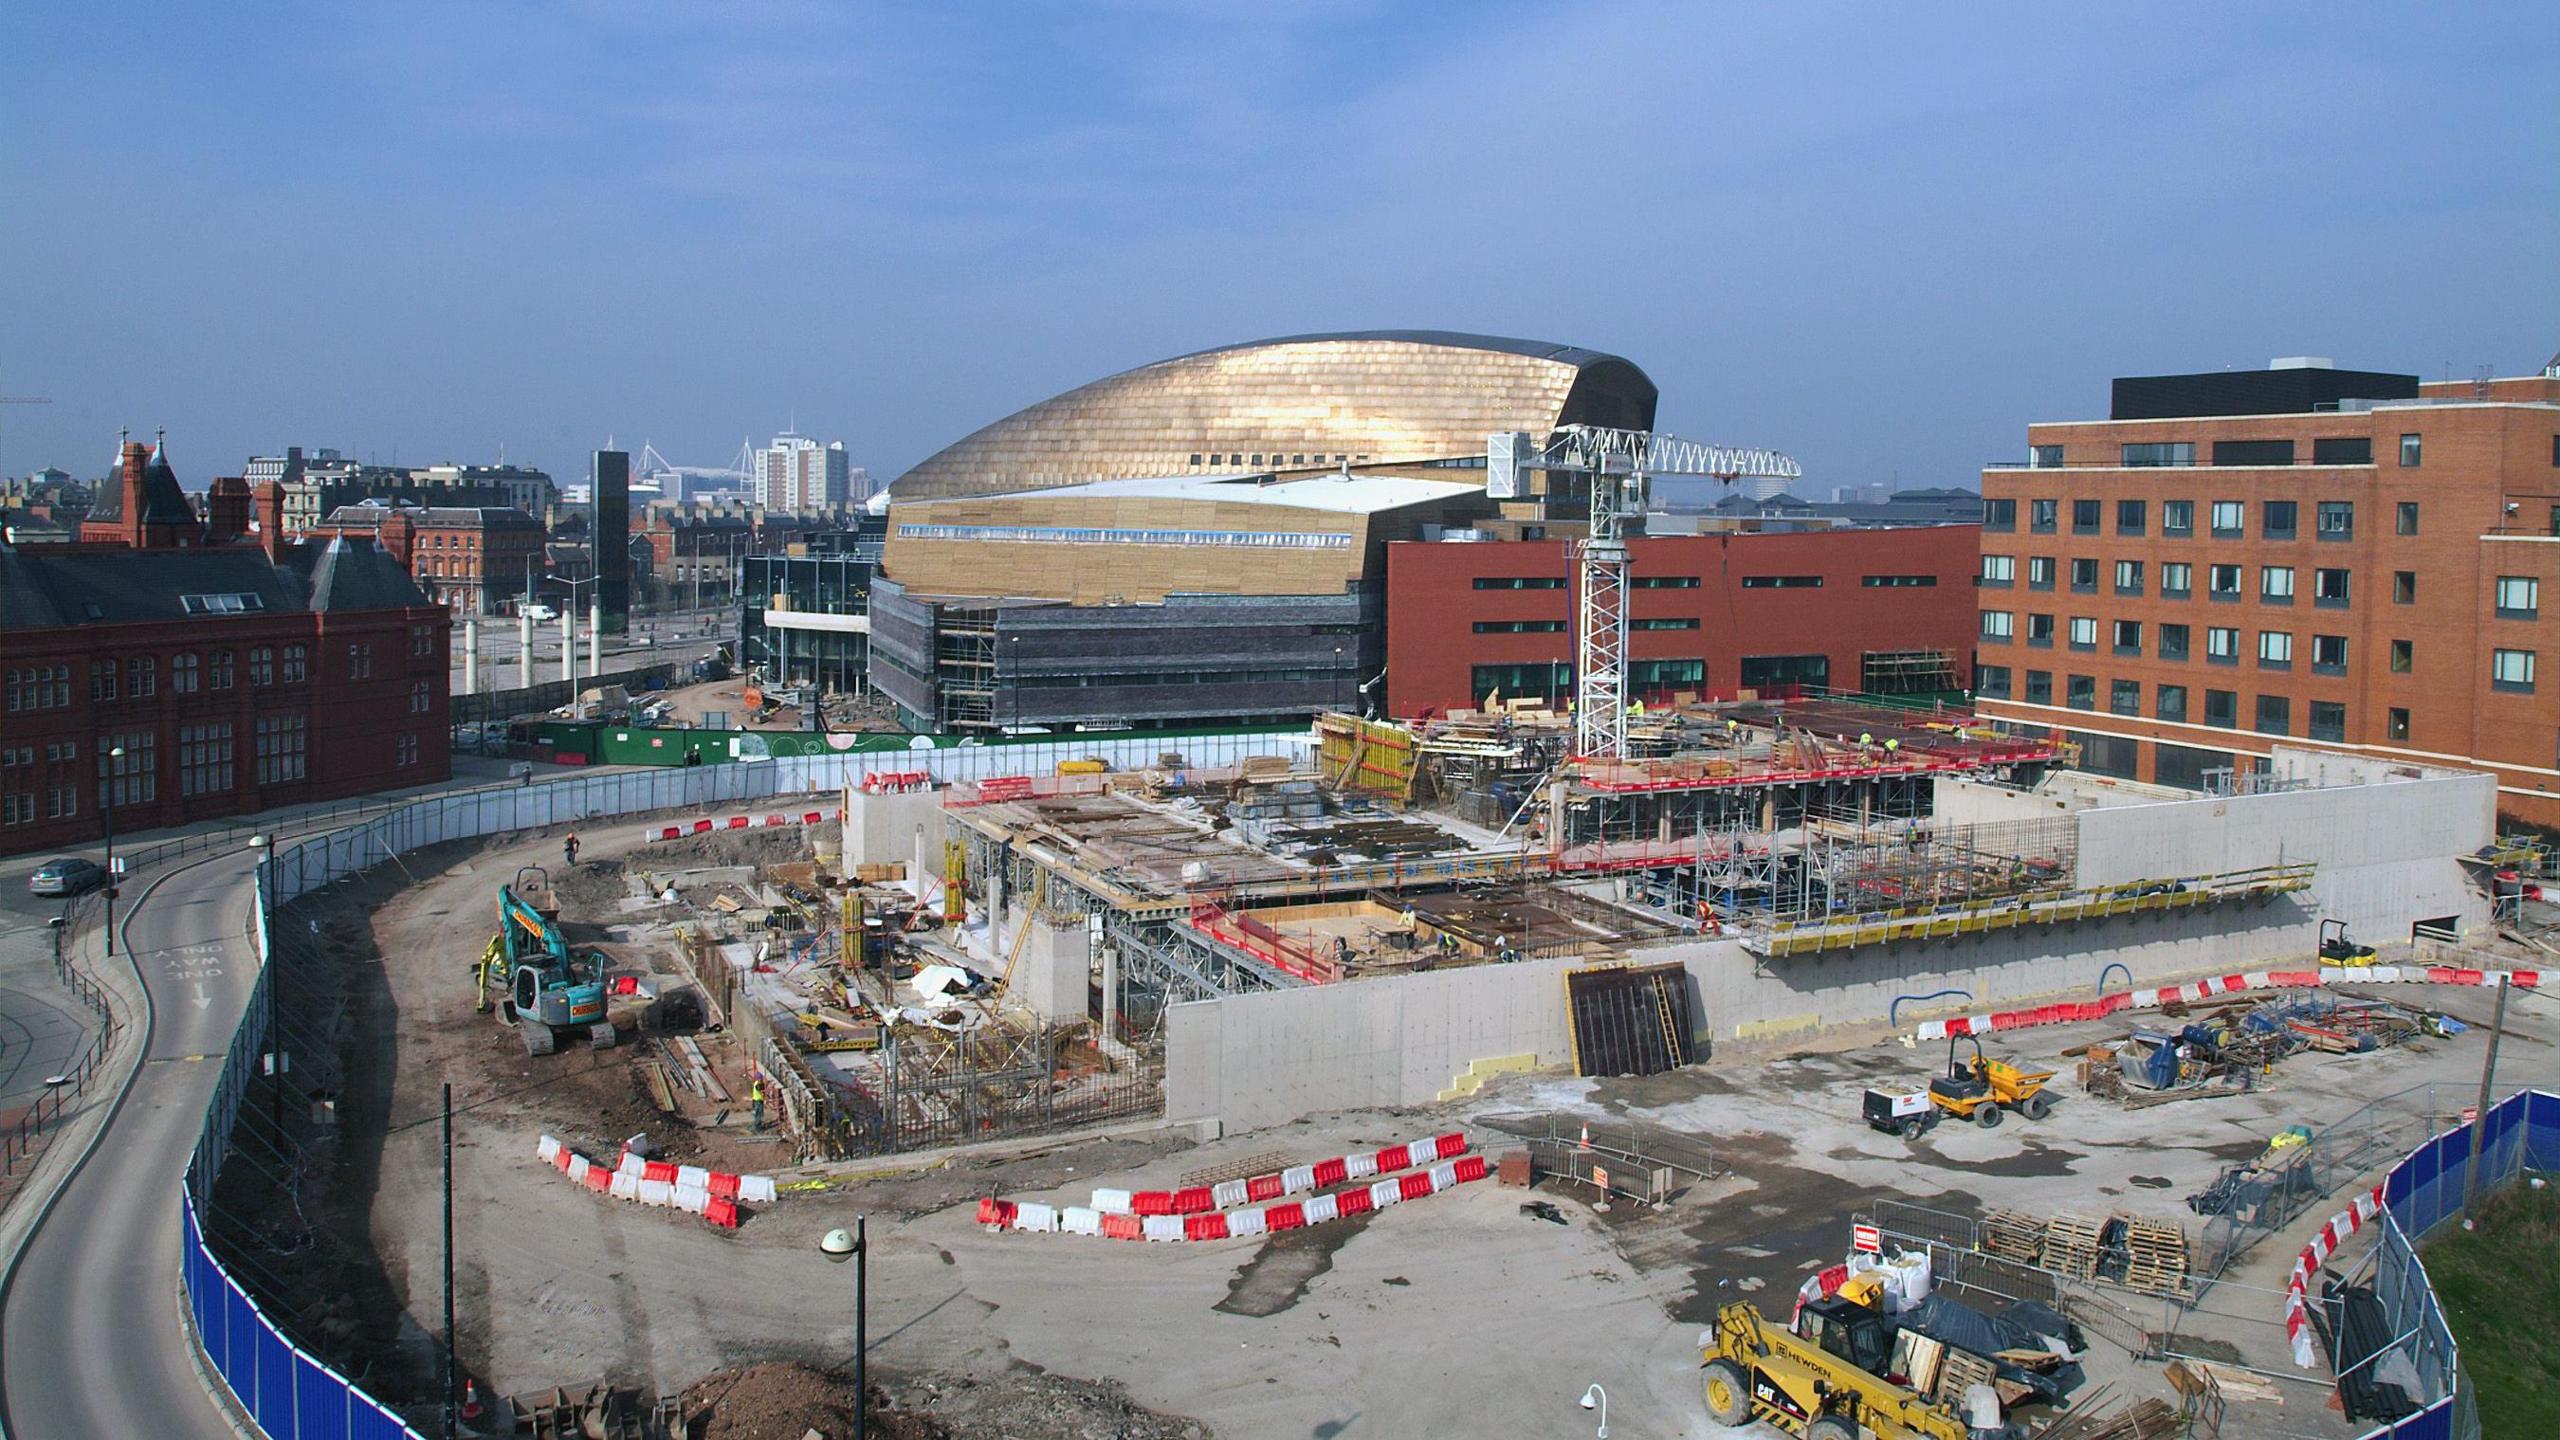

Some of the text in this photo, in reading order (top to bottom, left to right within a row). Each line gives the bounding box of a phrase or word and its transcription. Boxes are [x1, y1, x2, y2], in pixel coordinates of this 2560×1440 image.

[165, 957, 220, 969] WAY
[1788, 1351, 1831, 1379] HEWDEN
[1757, 1384, 1775, 1402] CAT
